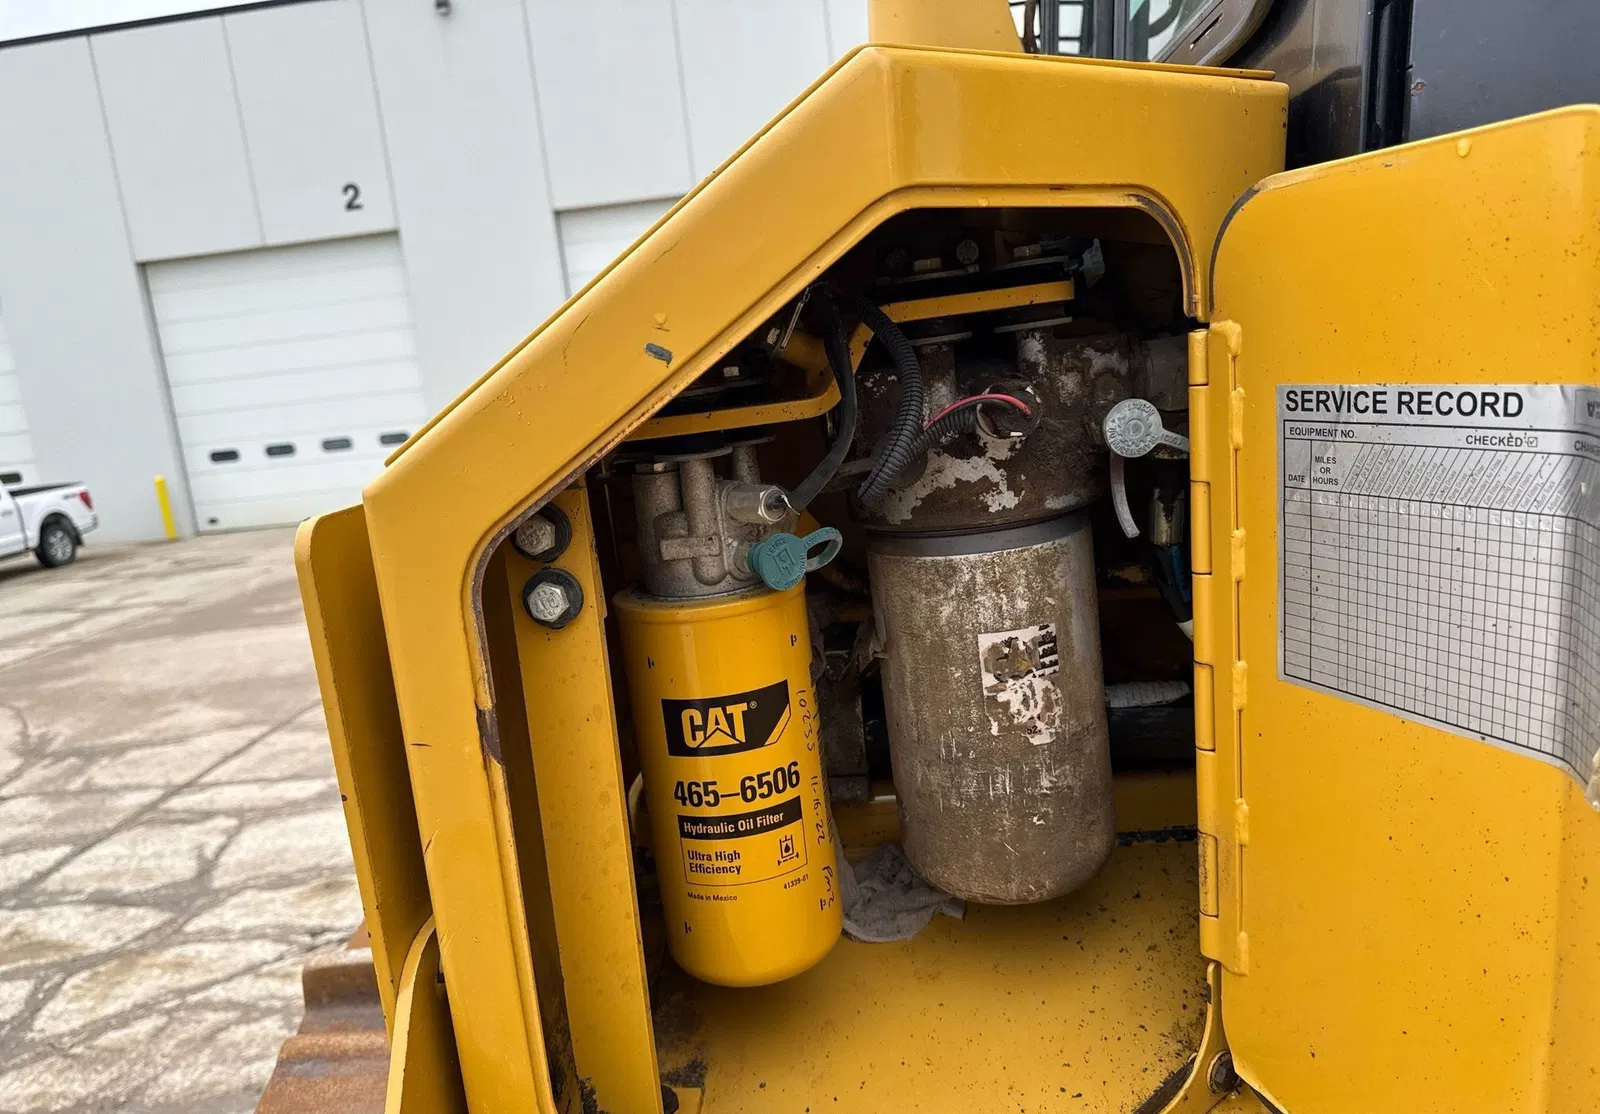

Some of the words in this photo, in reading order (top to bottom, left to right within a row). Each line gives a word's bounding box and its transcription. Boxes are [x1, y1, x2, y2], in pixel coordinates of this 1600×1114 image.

[341, 182, 364, 211] 2
[1285, 390, 1387, 414] SERVICE
[1397, 391, 1523, 417] RECORD
[1290, 427, 1338, 437] EQUIPMENT
[1341, 430, 1357, 439] NO.
[1466, 435, 1523, 447] CHECKED
[1315, 456, 1336, 464] MILES
[1288, 474, 1305, 483] DATE
[1313, 477, 1338, 485] HOURS
[673, 761, 800, 807] 465-6506
[684, 822, 735, 836] Hydraulic
[738, 819, 754, 831] Oil
[756, 812, 784, 827] Filter
[687, 850, 712, 862] Ultra
[715, 850, 741, 863] High
[689, 862, 741, 875] Efficiency
[687, 891, 703, 900] Made
